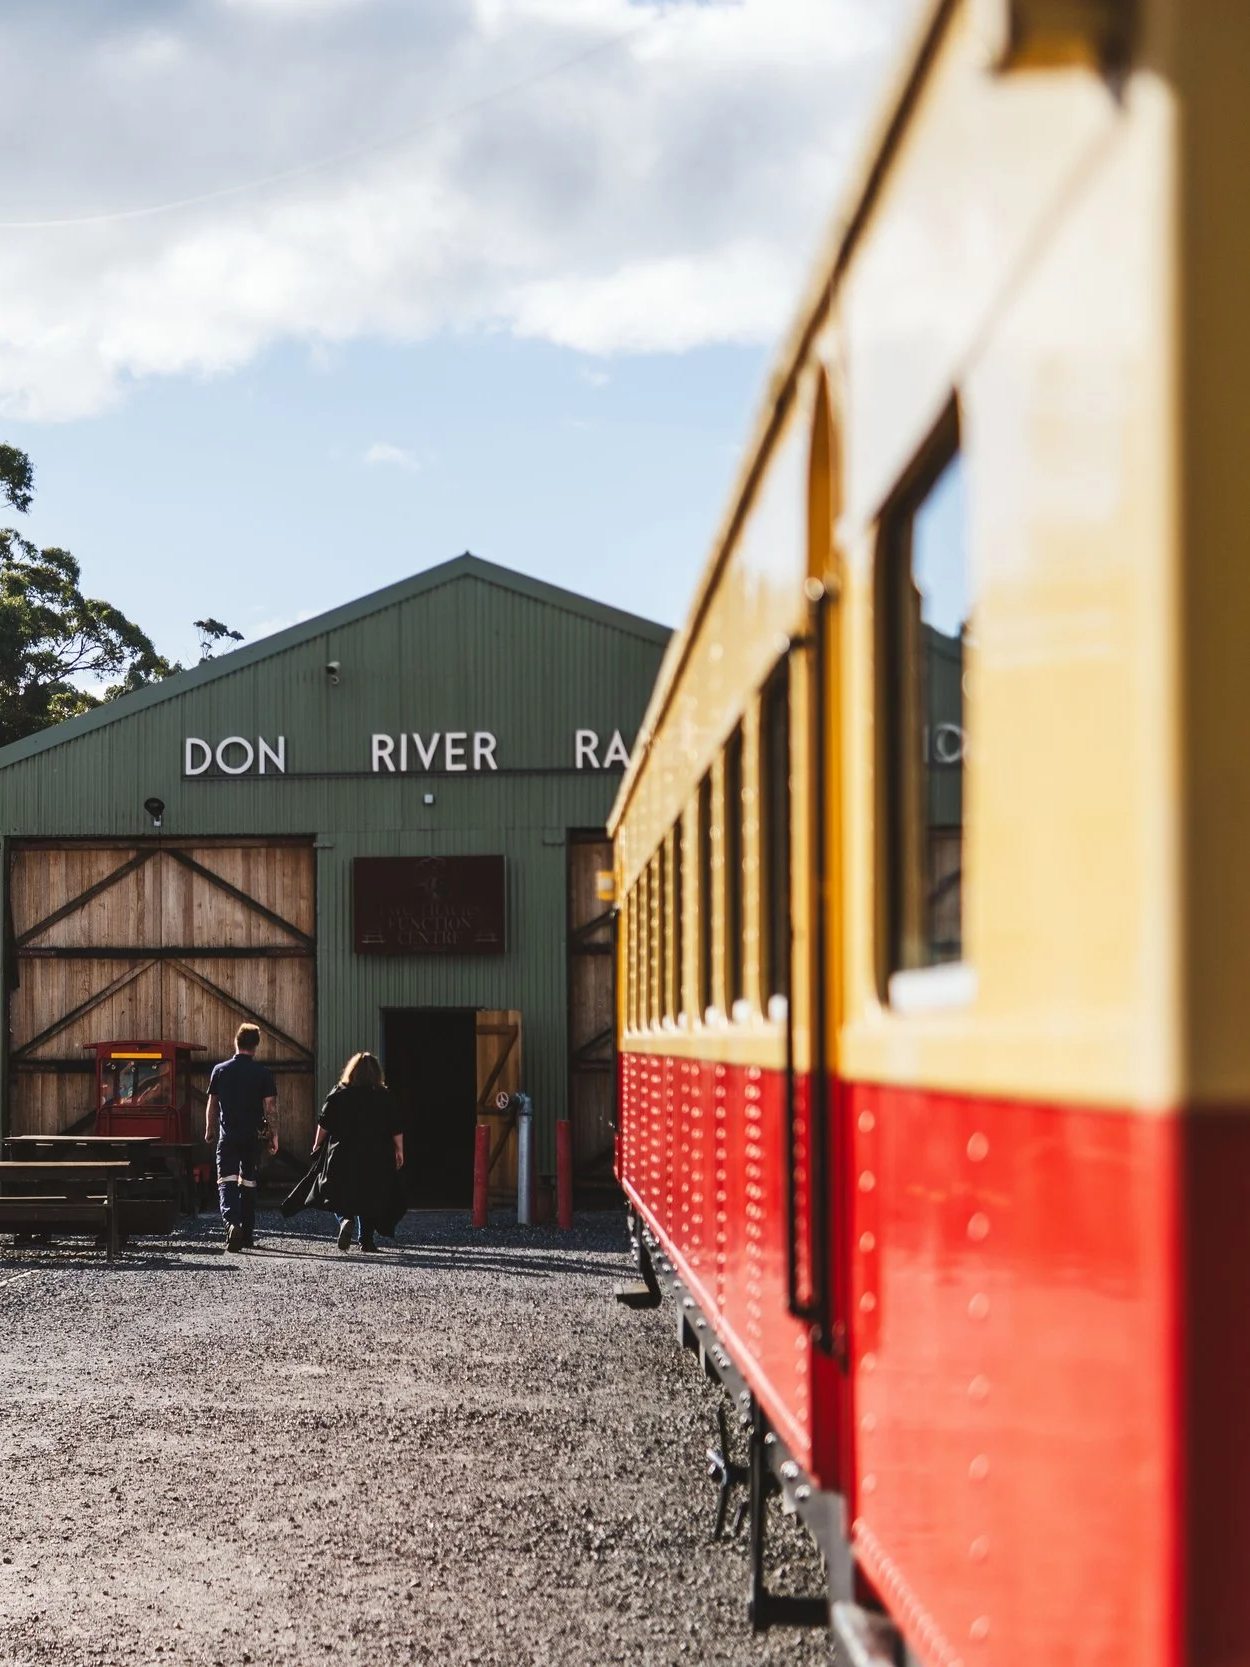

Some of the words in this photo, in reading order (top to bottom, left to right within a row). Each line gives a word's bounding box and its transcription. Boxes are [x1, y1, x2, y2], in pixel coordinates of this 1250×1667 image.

[185, 736, 285, 775] DON
[372, 732, 498, 772] RIVER
[388, 916, 472, 931] FUNCTION
[397, 930, 462, 945] CENTRE
